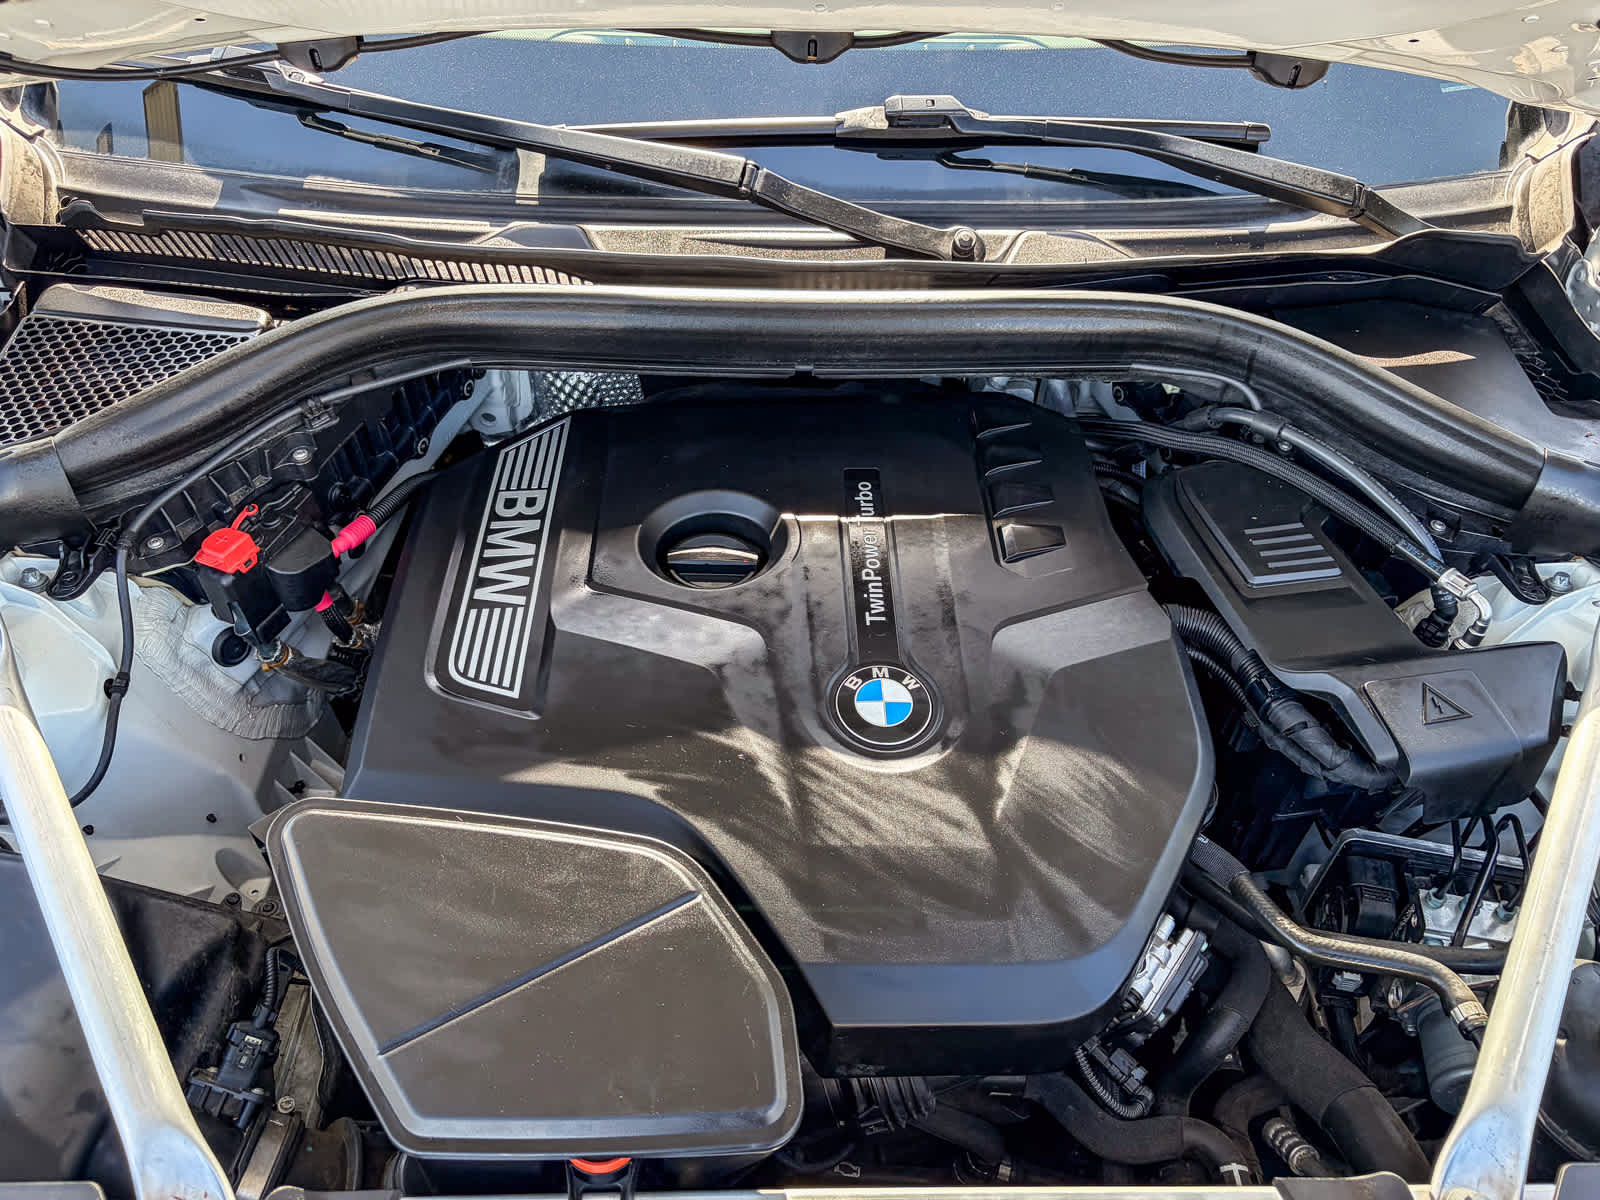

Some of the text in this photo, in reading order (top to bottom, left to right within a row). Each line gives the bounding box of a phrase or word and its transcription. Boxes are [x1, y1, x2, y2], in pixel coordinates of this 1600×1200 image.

[473, 489, 548, 606] BMW
[862, 528, 887, 626] TwinPower
[844, 667, 921, 691] BMW
